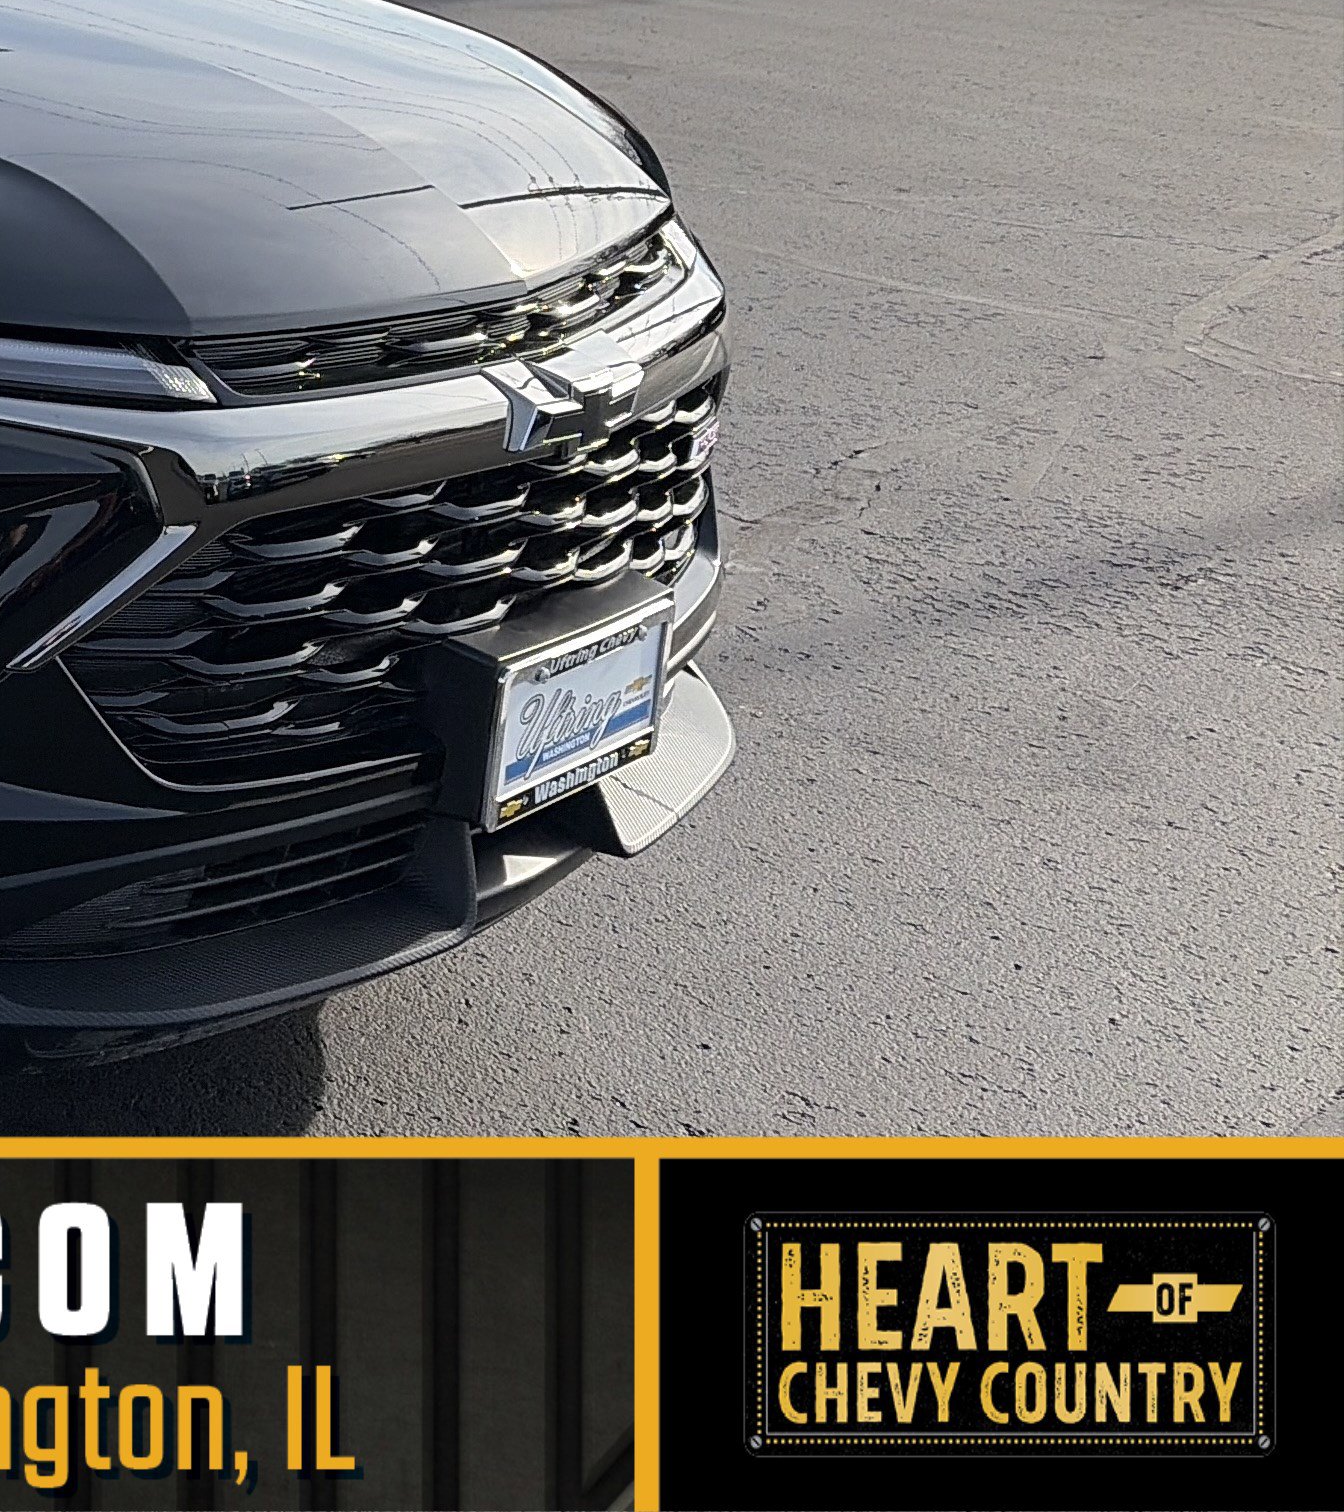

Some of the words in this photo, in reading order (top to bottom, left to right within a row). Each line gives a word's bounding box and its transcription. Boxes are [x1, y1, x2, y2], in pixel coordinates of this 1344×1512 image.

[515, 687, 623, 780] Uftring
[542, 731, 591, 762] WASHINGTON
[534, 752, 619, 805] Washington
